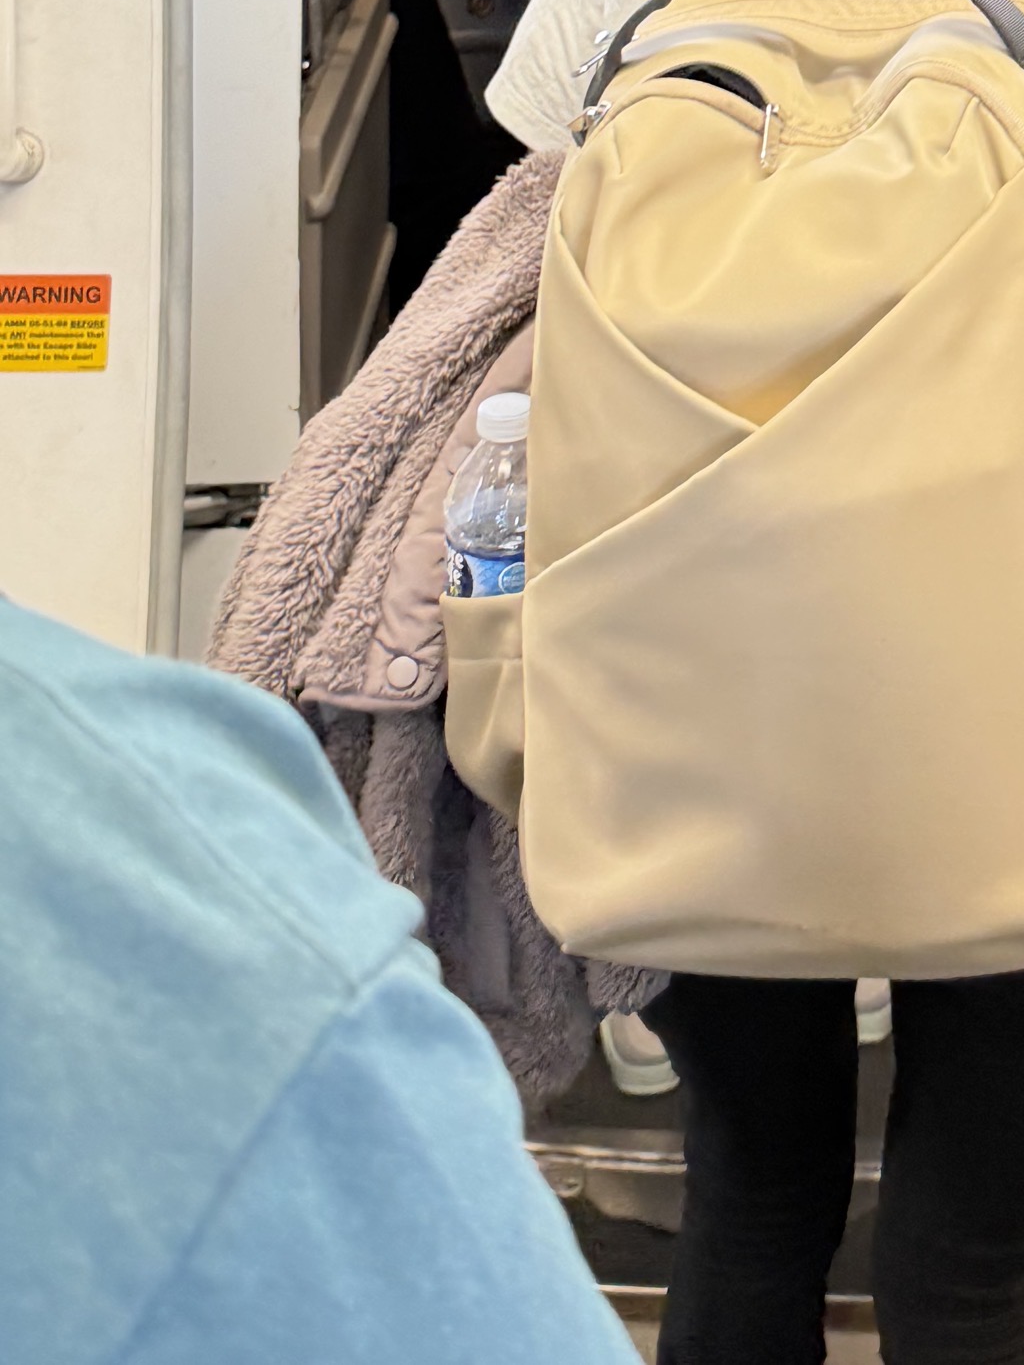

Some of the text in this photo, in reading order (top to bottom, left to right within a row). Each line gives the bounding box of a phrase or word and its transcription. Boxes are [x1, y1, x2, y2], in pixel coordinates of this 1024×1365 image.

[0, 286, 101, 304] WARNING
[70, 320, 105, 329] BEFORE
[87, 331, 105, 339] that
